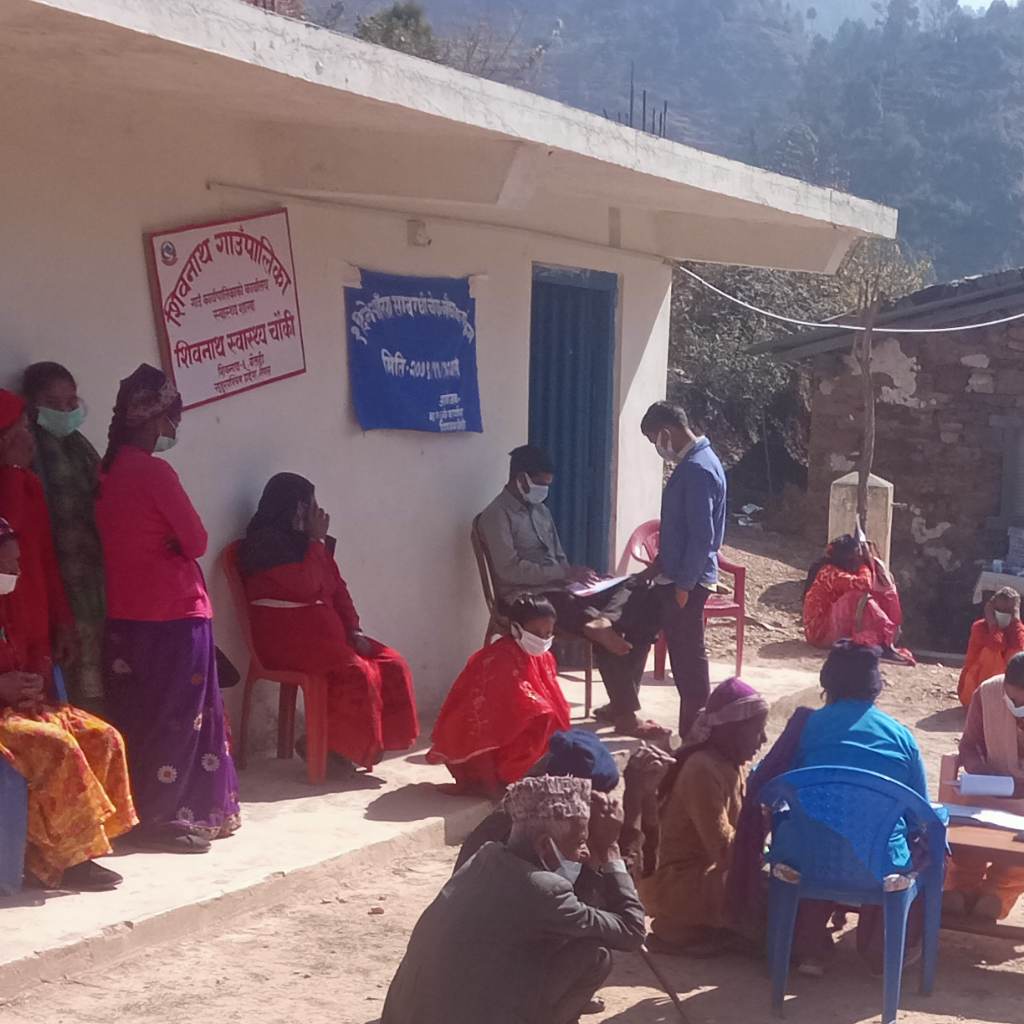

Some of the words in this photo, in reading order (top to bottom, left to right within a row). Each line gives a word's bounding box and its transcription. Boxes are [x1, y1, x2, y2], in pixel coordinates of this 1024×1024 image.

[163, 237, 215, 327] शिवनाथ
[174, 335, 225, 369] शिवनाथ
[226, 322, 267, 354] स्वास्थ्य
